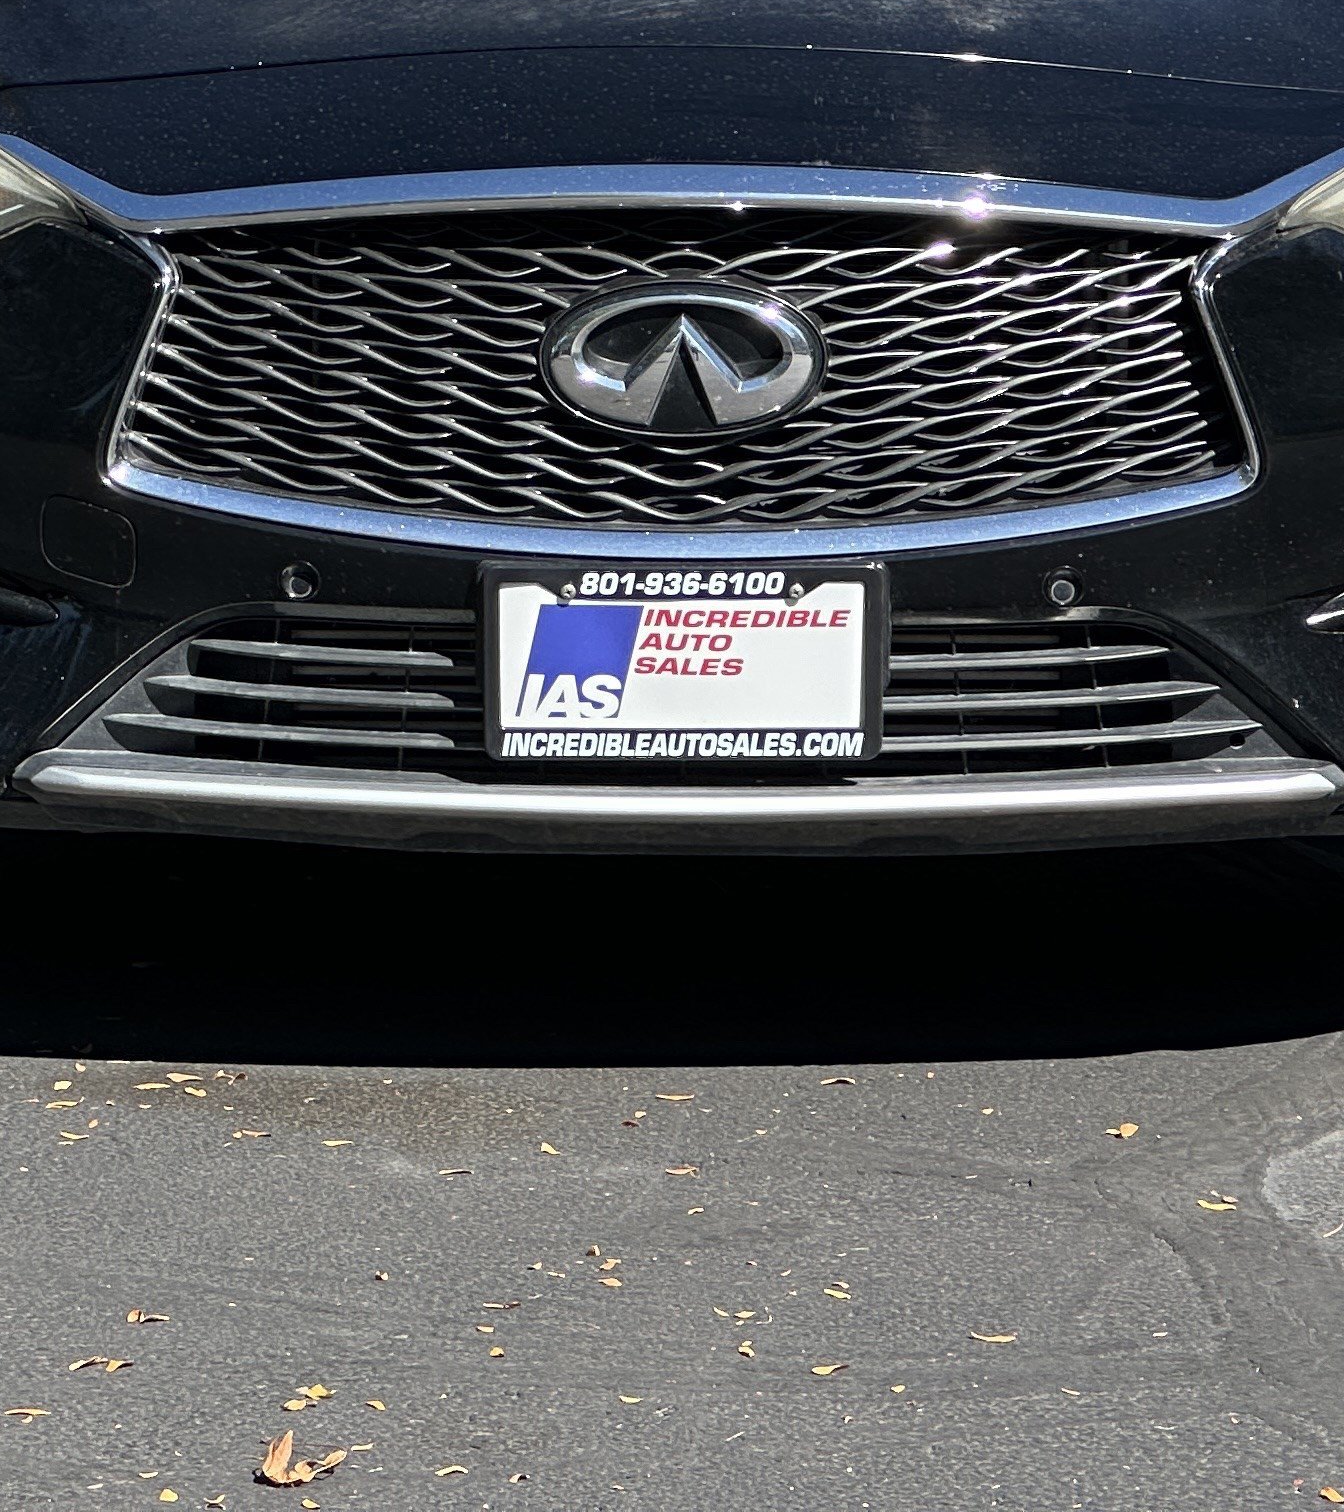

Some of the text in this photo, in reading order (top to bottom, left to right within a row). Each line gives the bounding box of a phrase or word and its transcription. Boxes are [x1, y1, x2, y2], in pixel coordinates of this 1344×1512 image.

[579, 571, 785, 597] 801-936-6100
[643, 609, 851, 628] INCREDIBLE
[639, 633, 733, 652] AUTO
[634, 657, 745, 676] SALES
[518, 673, 623, 720] IAS
[501, 731, 864, 758] INCREDIBLEAUTOSALES.COM
